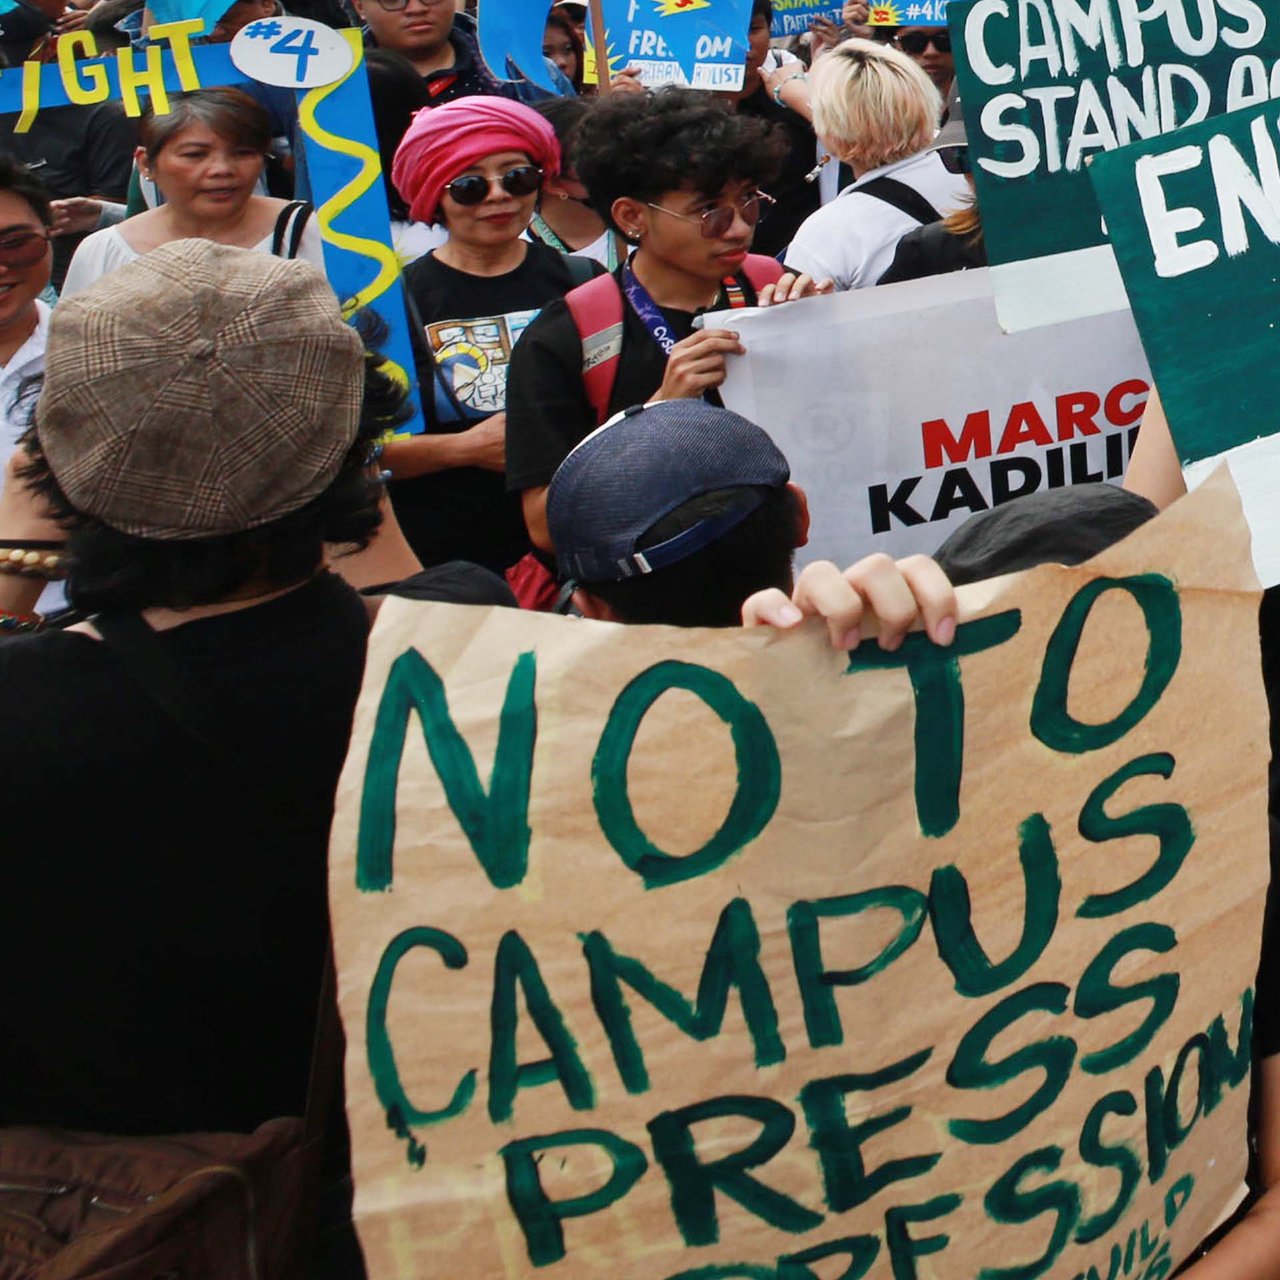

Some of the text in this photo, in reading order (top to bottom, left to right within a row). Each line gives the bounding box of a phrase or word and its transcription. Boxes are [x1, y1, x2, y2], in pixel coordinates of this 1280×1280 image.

[243, 20, 319, 83] #4
[976, 62, 1211, 179] STAND
[921, 378, 1151, 469] MARC
[355, 572, 1183, 893] NO TO
[364, 751, 1197, 1145] CAMPUS
[498, 921, 1183, 1269] PRESS
